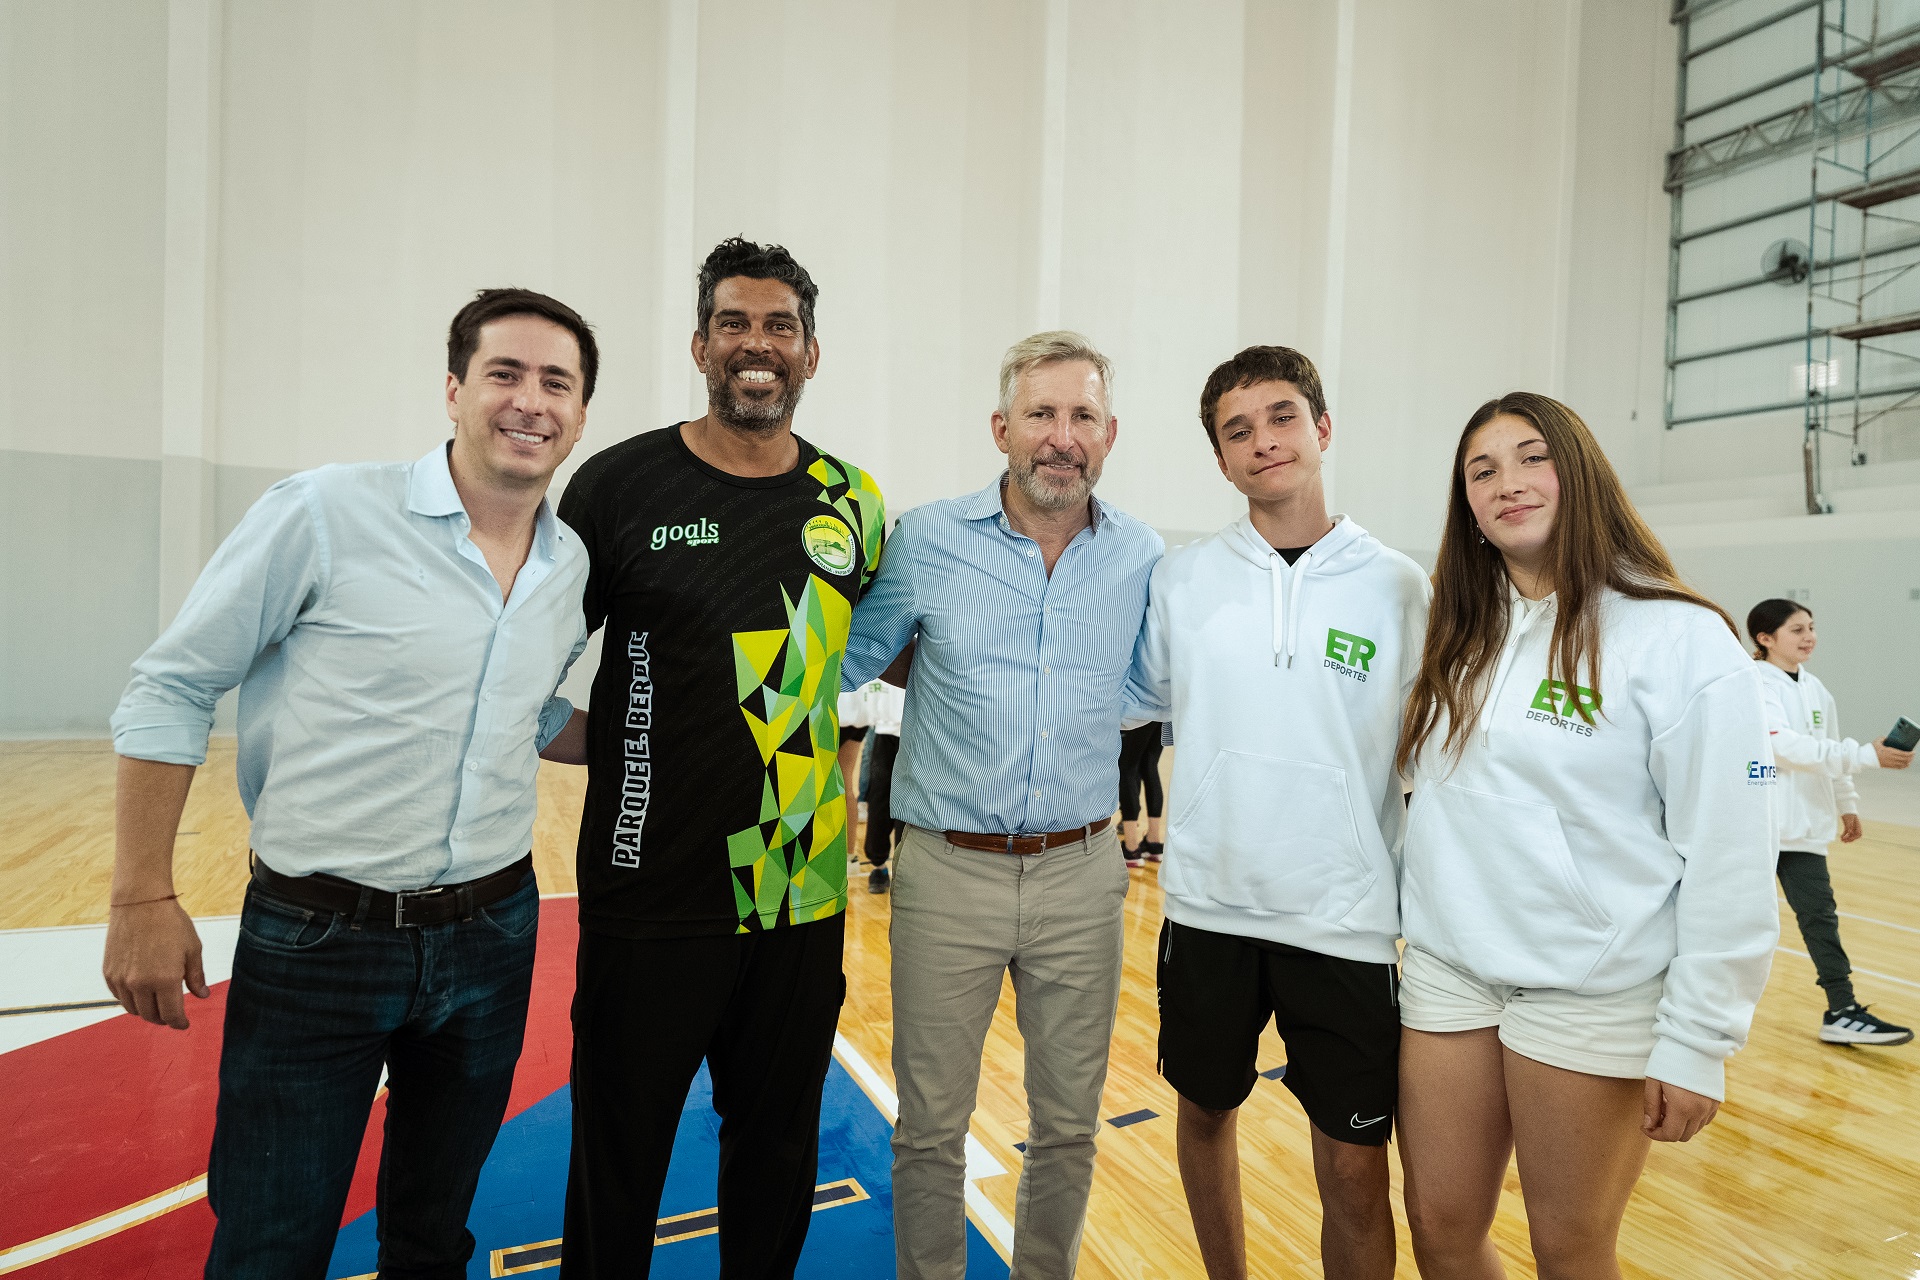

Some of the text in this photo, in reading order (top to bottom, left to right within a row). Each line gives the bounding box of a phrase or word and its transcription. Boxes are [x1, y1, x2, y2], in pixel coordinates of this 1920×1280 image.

[650, 517, 719, 551] goals
[686, 537, 720, 547] sport
[1325, 627, 1376, 673] ER
[1323, 659, 1368, 683] DEPORTES
[1530, 678, 1603, 726] ER
[1525, 710, 1594, 737] DEPORTES
[624, 733, 650, 759] E.
[612, 760, 651, 868] PARQUE
